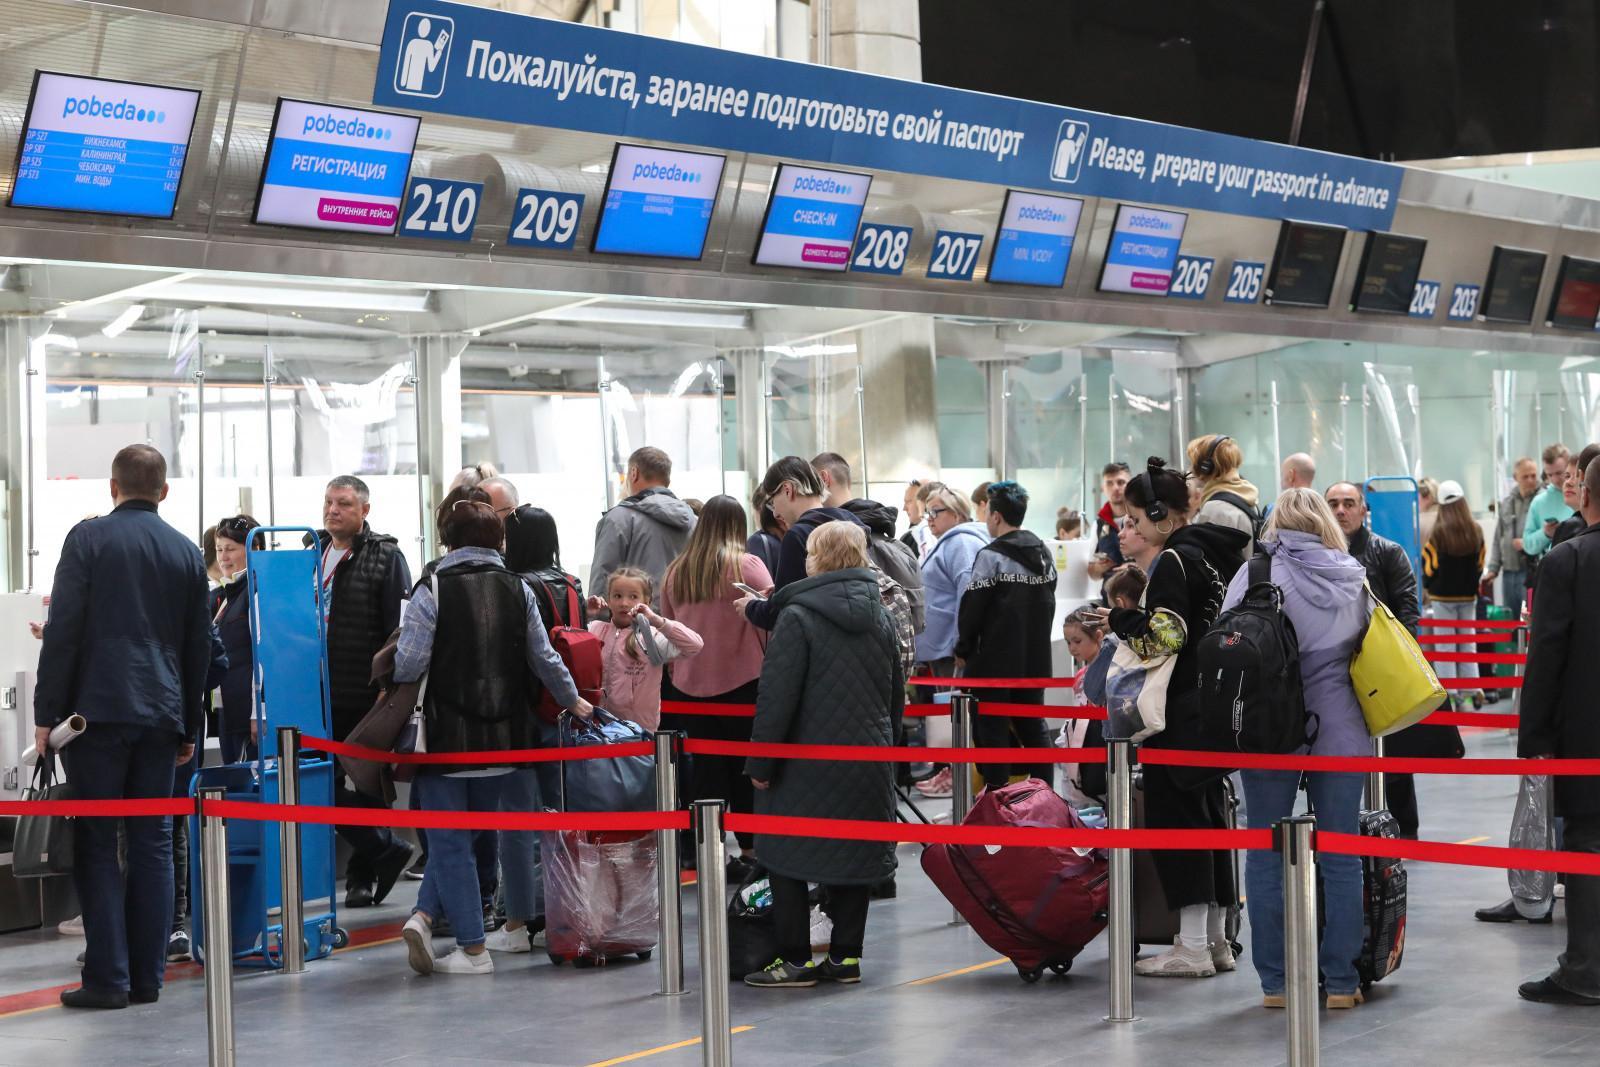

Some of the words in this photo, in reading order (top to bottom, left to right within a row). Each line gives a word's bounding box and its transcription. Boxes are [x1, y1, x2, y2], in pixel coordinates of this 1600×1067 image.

[63, 96, 136, 120] pobeda
[466, 40, 639, 109] Пожалуйста,
[646, 76, 747, 118] заранее
[752, 92, 888, 136] подготовьте
[892, 108, 942, 144] свой
[944, 122, 1024, 162] паспорт
[303, 114, 366, 138] pobeda
[84, 136, 127, 150] НИЖНЕКАМСК
[78, 162, 116, 174] ЧЕБОКСАРЫ
[80, 149, 127, 164] КАЛИНИНГРАД
[291, 154, 388, 181] РЕГИСТРАЦИЯ
[93, 176, 112, 186] ВОДЫ
[632, 162, 682, 182] pobeda
[793, 174, 836, 194] pobeda
[1088, 136, 1146, 179] Please,
[1152, 153, 1216, 186] prepare
[1215, 164, 1254, 192] your
[1252, 170, 1319, 202] passport
[1318, 175, 1332, 200] in
[1333, 180, 1388, 210] advance
[323, 203, 368, 217] ВНУТРЕННИЕ
[370, 206, 394, 220] РЕЙСЫ
[405, 183, 476, 234] 210
[512, 194, 579, 244] 209
[793, 208, 838, 226] CHECK-IN
[1018, 206, 1053, 222] pobeda
[1129, 214, 1162, 230] pobeda
[855, 228, 910, 270] 208
[930, 235, 980, 275] 207
[1172, 260, 1212, 294] 206
[1228, 266, 1263, 299] 205
[1410, 284, 1438, 314] 204
[1450, 287, 1478, 316] 203
[1000, 572, 1016, 582] LOVE
